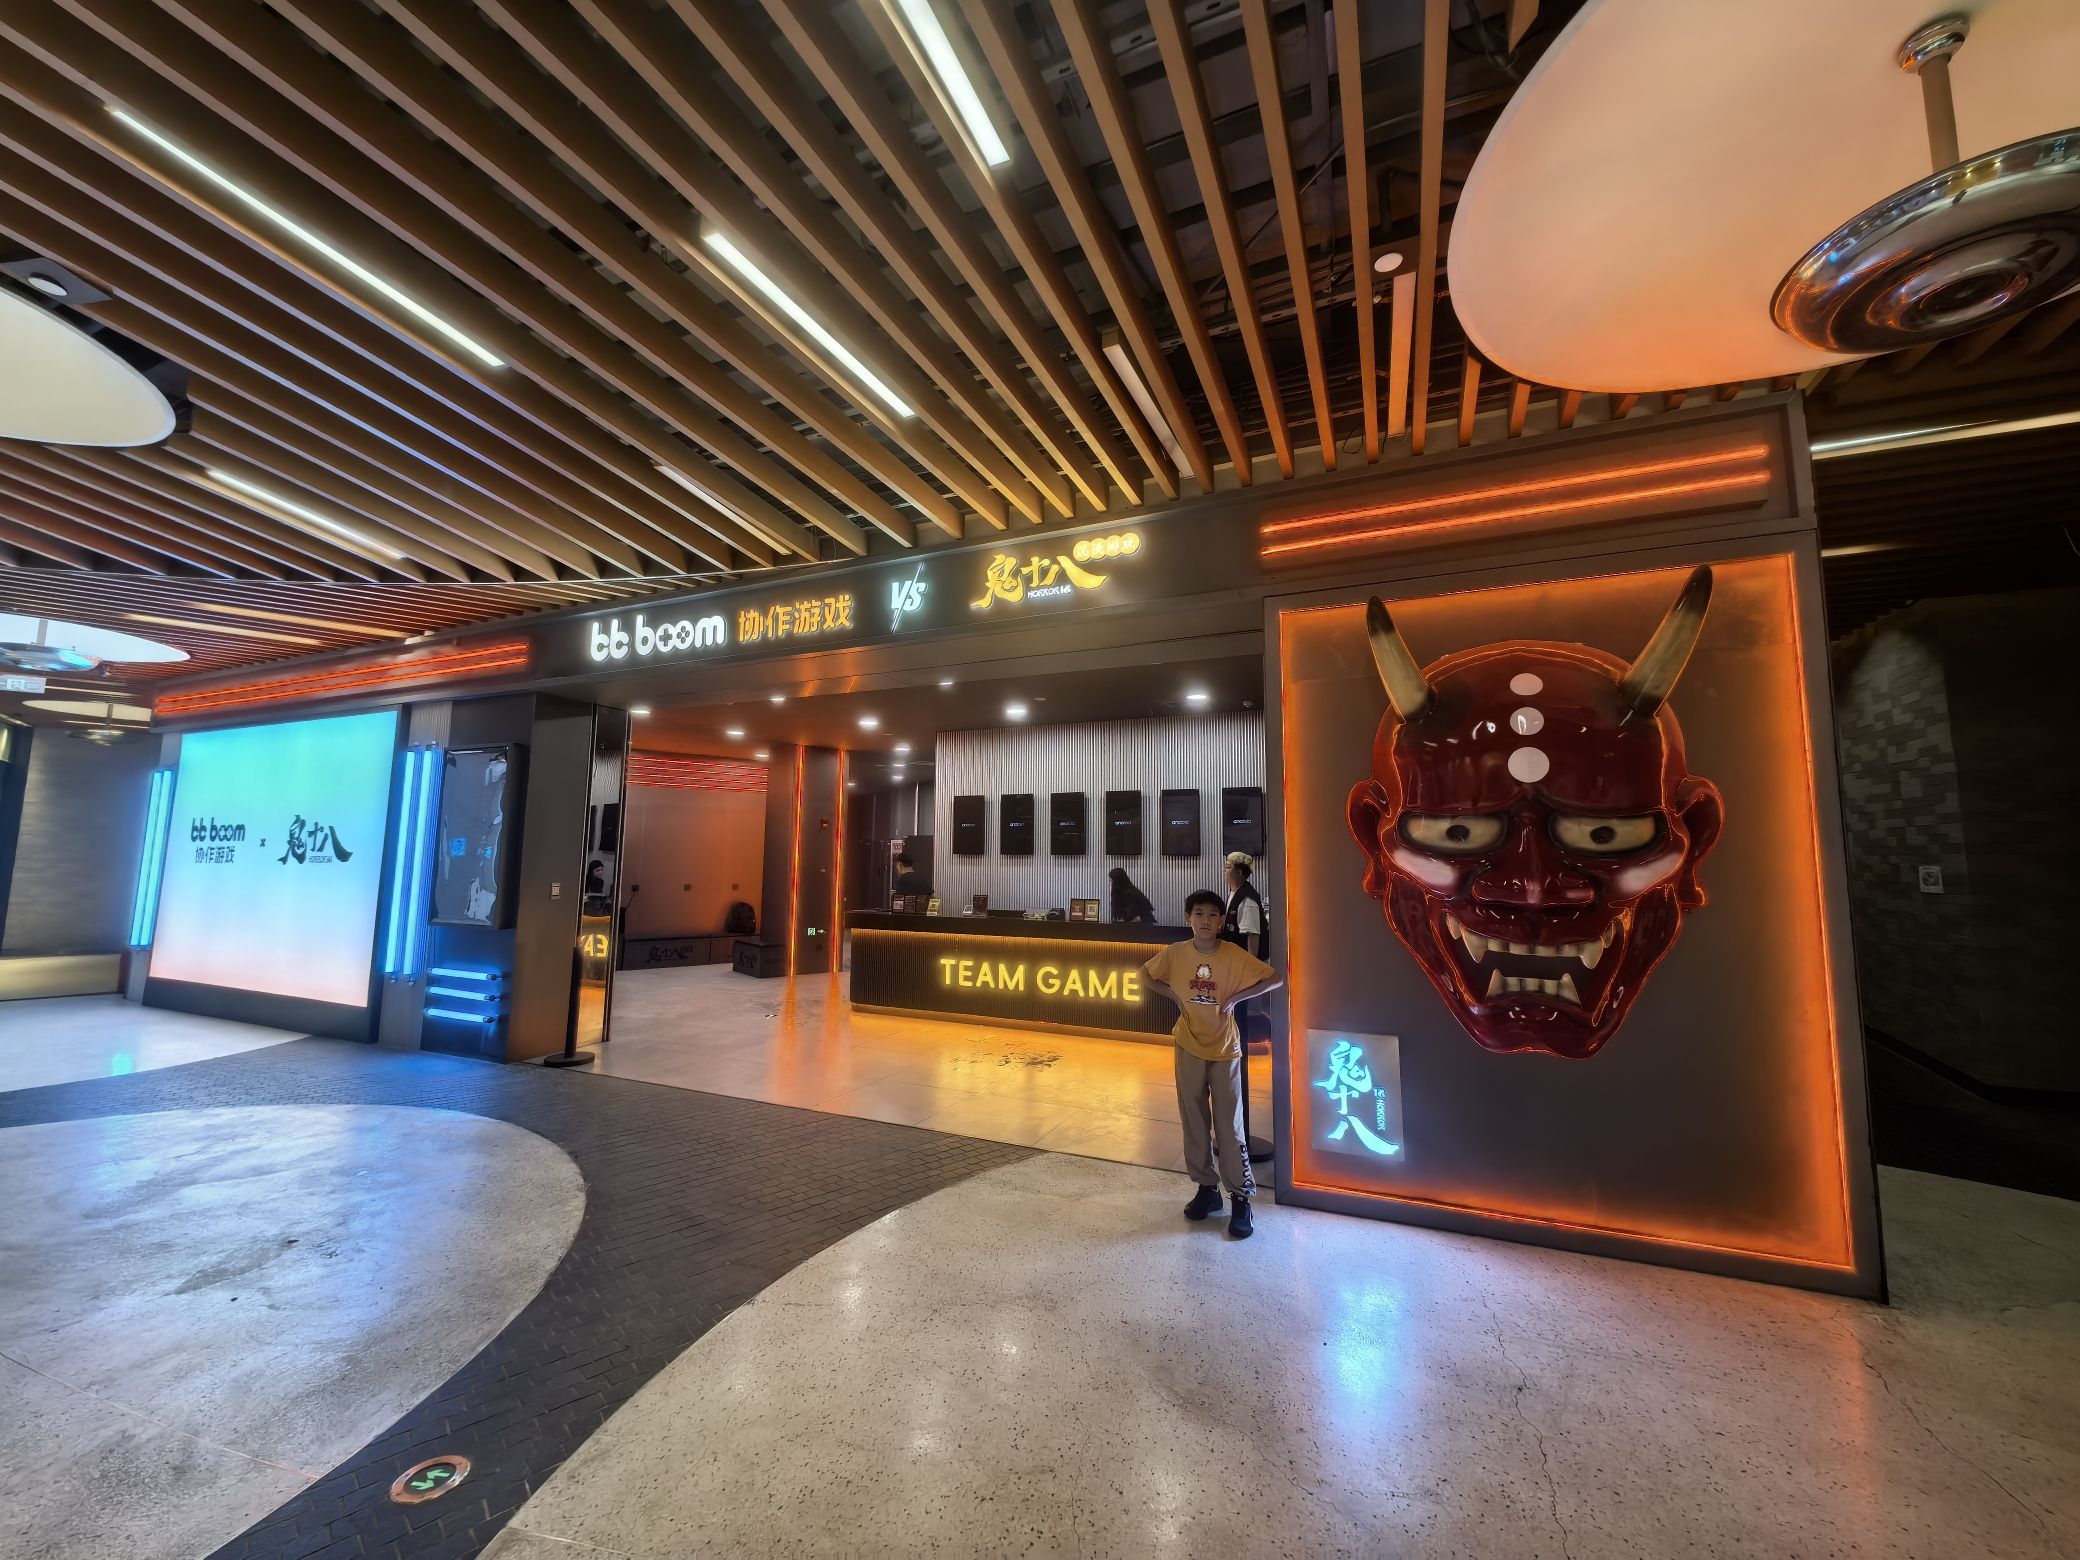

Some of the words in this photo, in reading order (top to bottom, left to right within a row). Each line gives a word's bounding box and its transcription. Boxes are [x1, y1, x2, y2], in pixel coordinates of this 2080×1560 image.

[738, 594, 853, 642] 协作游戏
[195, 846, 236, 864] 协作游戏
[940, 958, 1025, 992] TEAM
[1036, 966, 1141, 1002] GAME
[1311, 1040, 1400, 1155] 鬼十八
